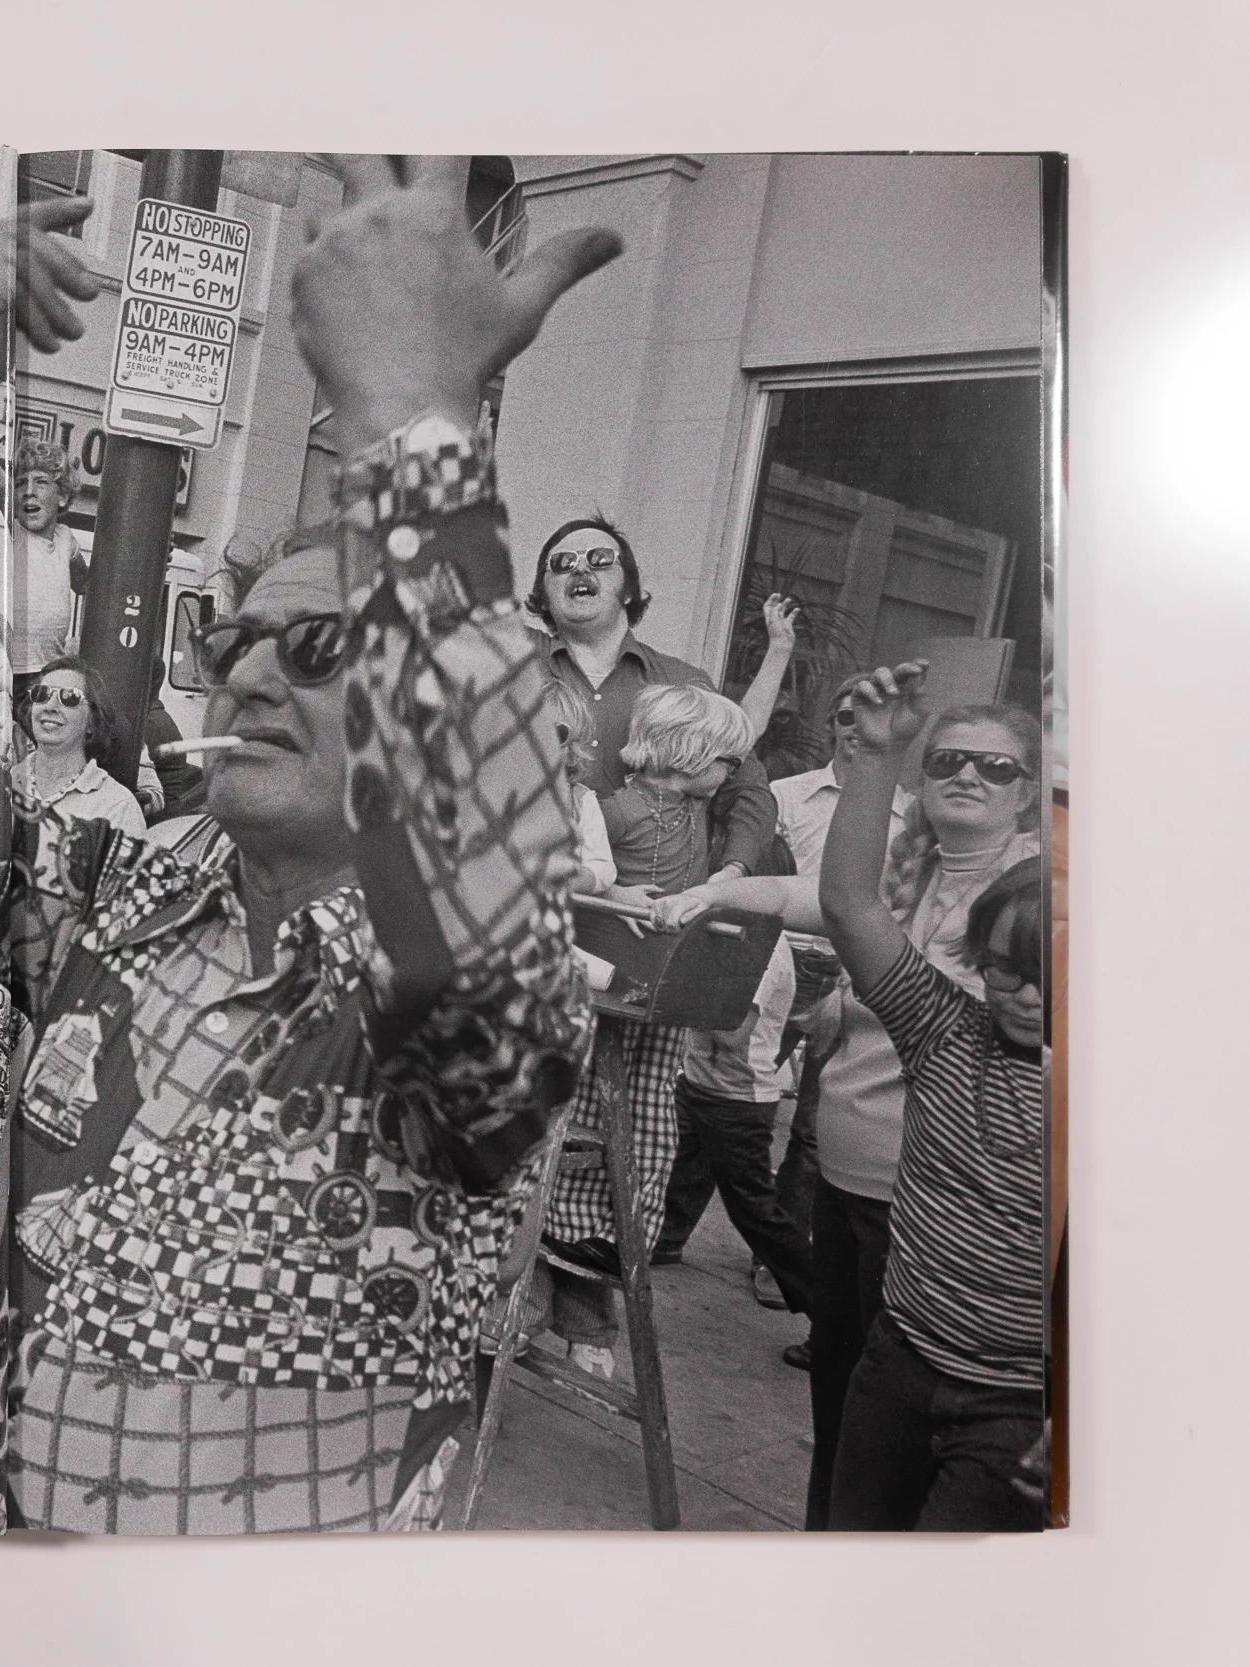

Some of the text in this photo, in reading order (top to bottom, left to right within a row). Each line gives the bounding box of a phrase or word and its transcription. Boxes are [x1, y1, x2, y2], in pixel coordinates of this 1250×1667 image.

[141, 203, 244, 247] NO STOPPING
[177, 266, 196, 276] AND
[127, 299, 228, 340] NO PARKING
[126, 361, 218, 386] SERVICE TRUCK ZONE
[127, 351, 219, 376] FREIGHT HANDLING &
